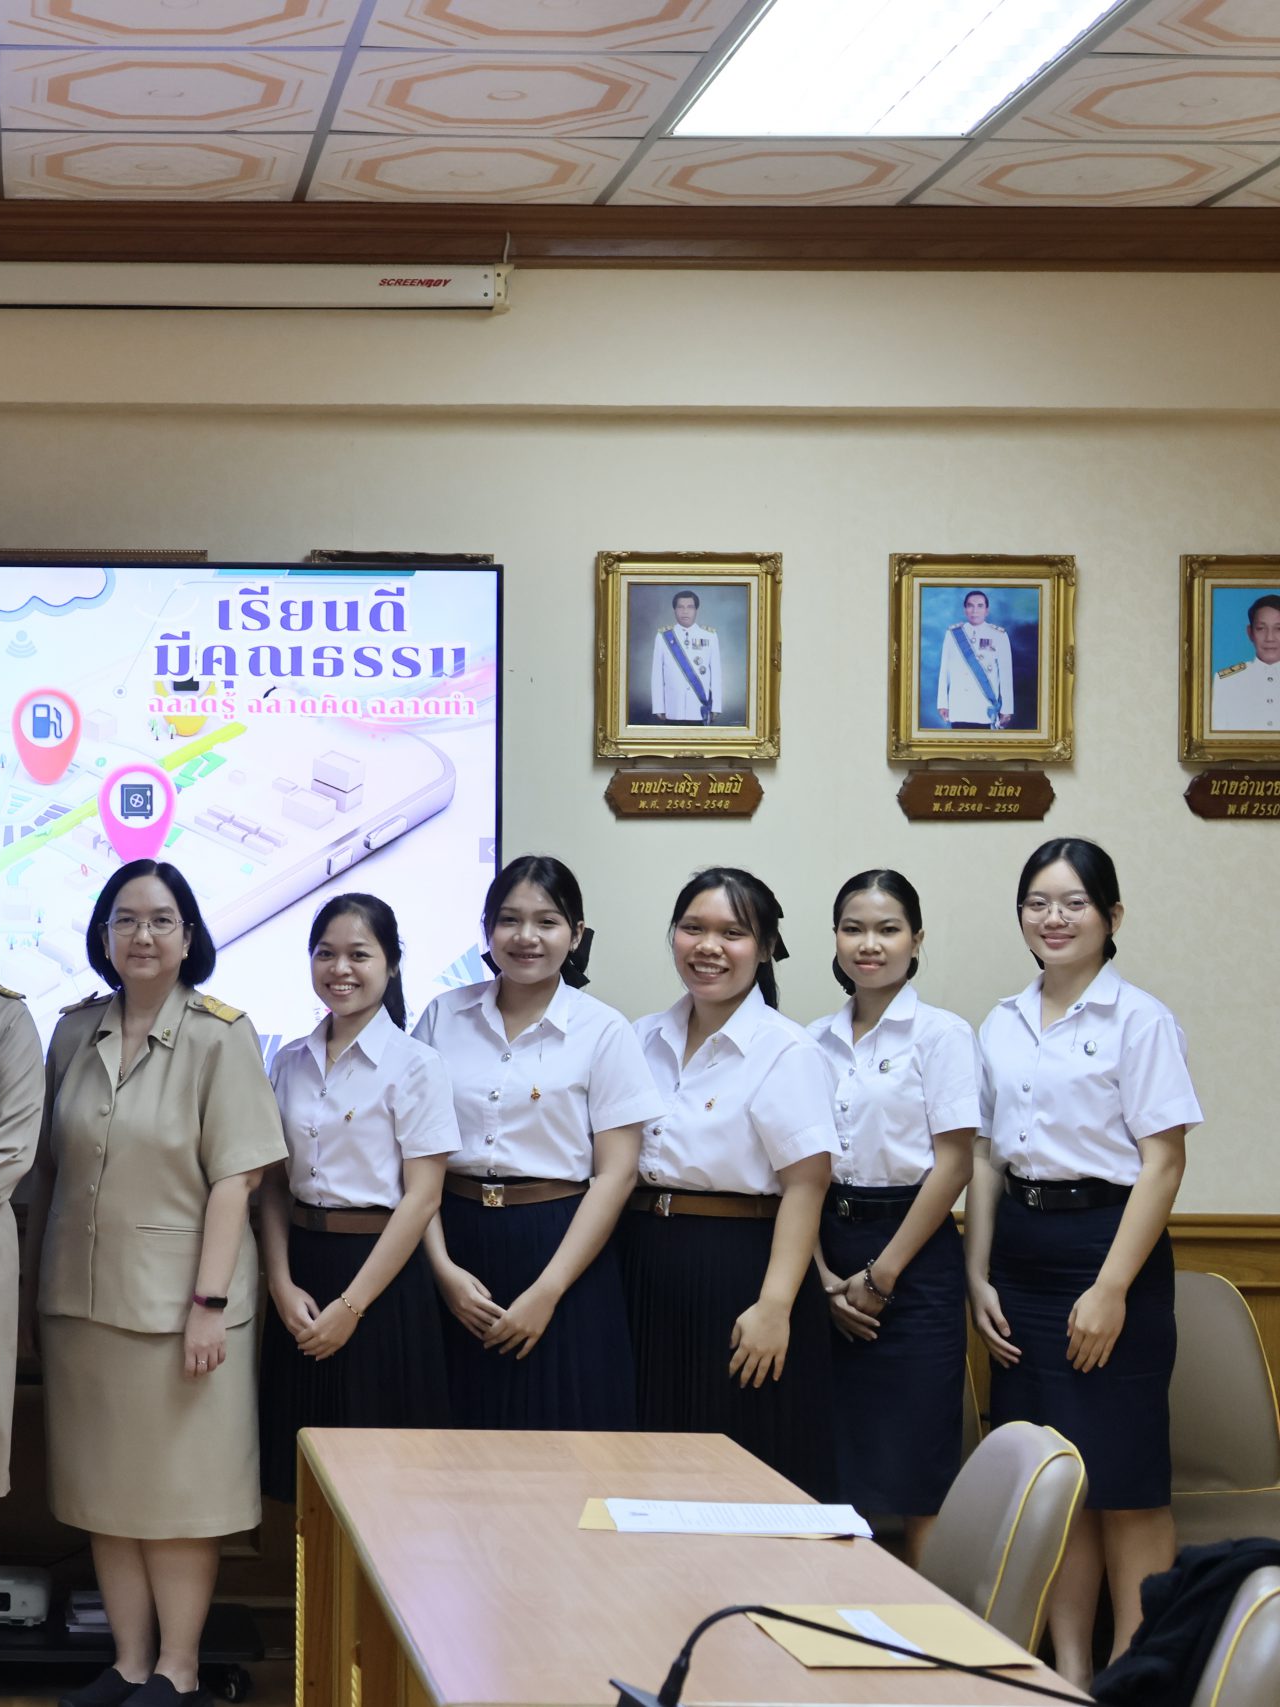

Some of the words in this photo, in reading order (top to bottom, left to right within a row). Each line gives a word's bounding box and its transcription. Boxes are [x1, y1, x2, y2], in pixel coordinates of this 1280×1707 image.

[218, 586, 407, 633] เรียนดี
[154, 631, 466, 689] มีคุณธรรม
[148, 692, 235, 719] ฉลาดรู้
[248, 694, 359, 716] ฉลาดคิด
[370, 694, 476, 717] ฉลาดทำ
